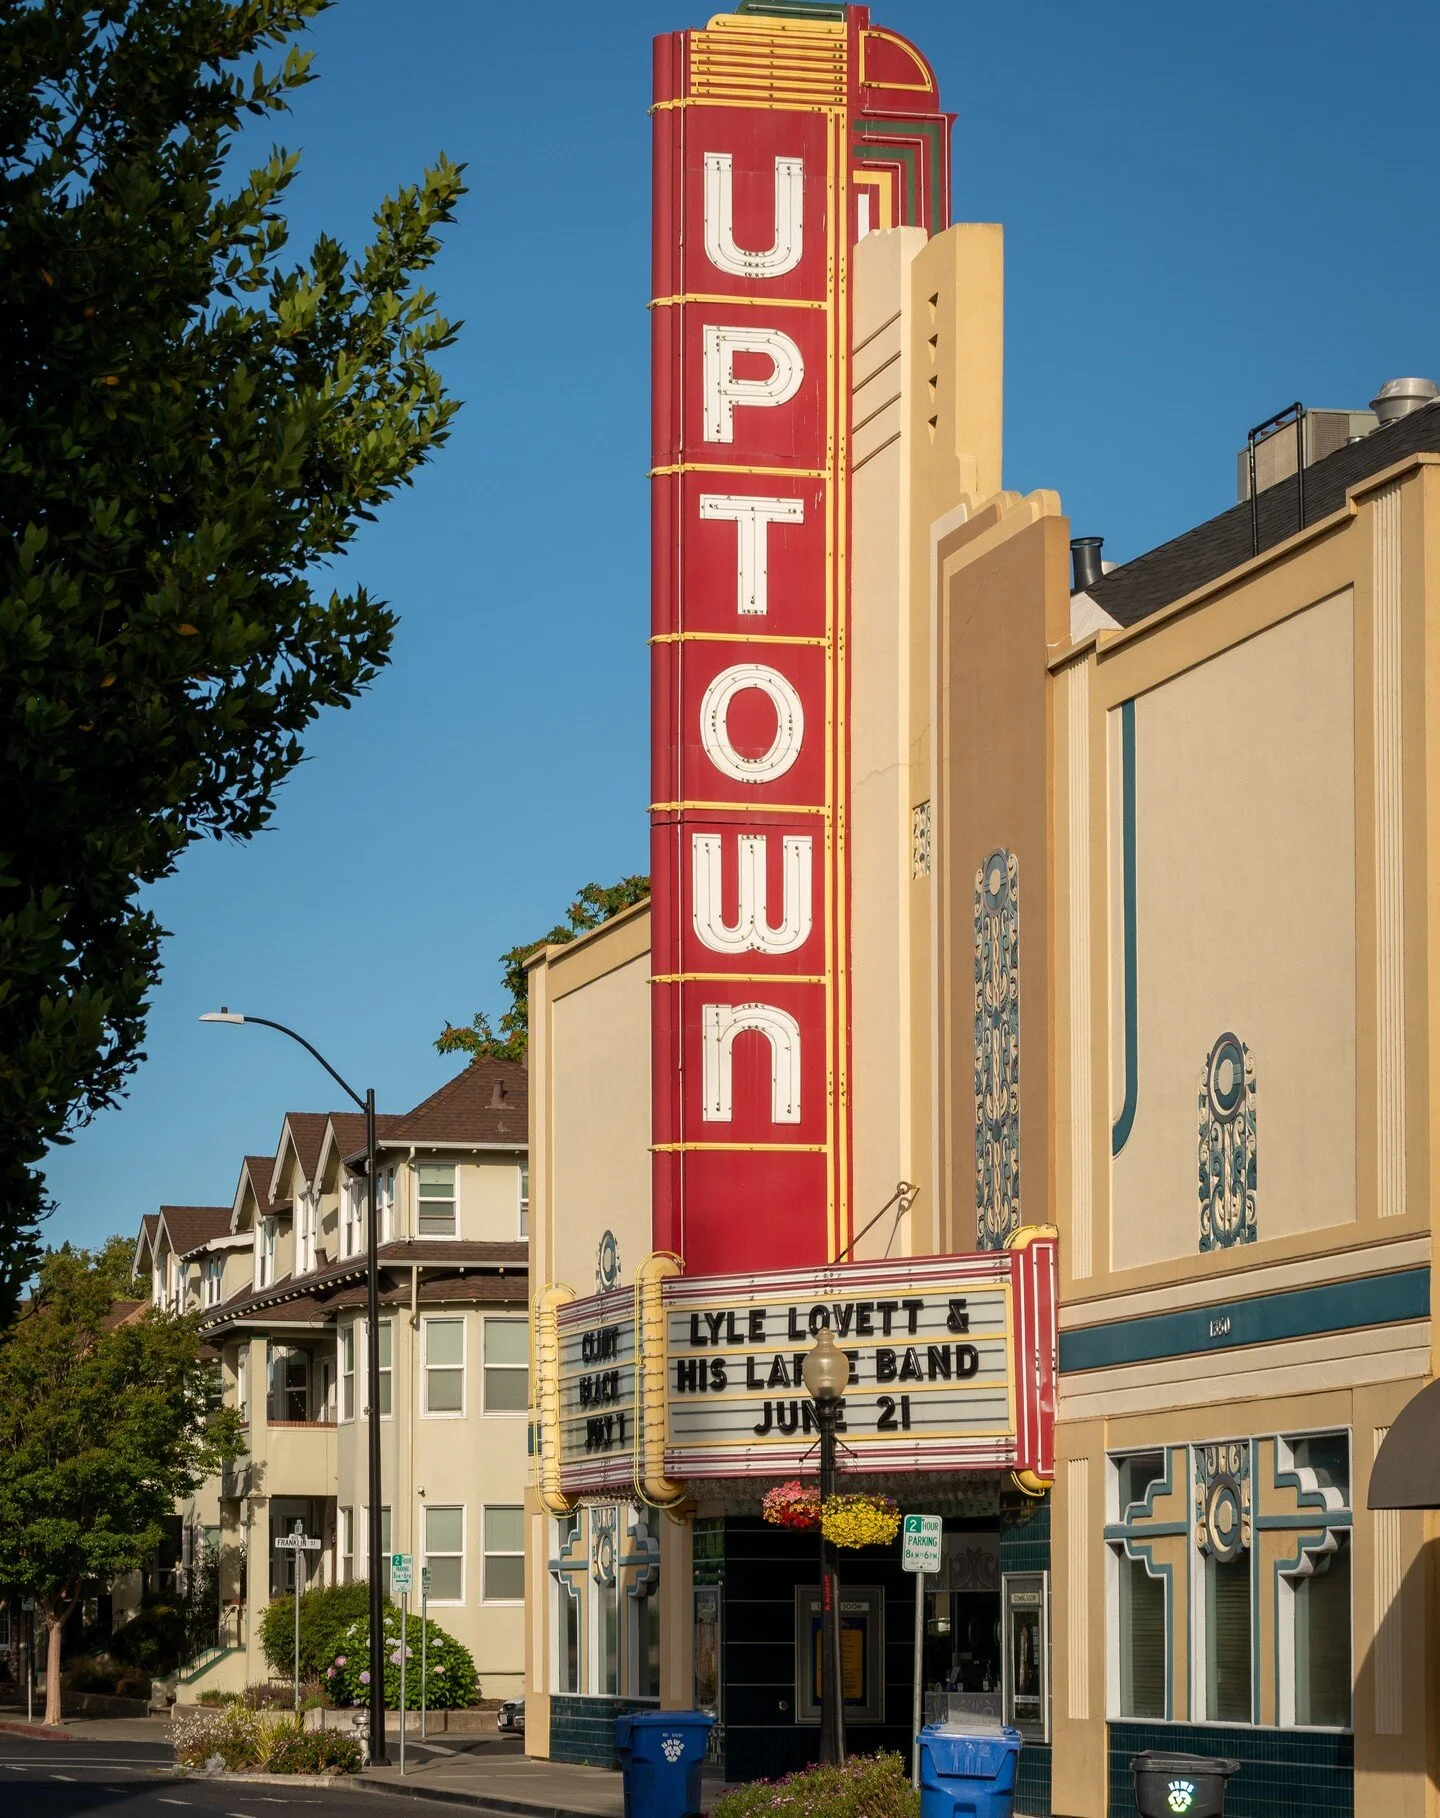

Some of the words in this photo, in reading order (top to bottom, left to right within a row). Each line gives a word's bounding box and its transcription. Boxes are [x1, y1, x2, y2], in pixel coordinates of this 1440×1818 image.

[692, 152, 814, 1124] UPTOWN
[690, 1309, 766, 1345] LYLE
[788, 1299, 924, 1341] LOVETT
[947, 1298, 970, 1334] &
[677, 1358, 728, 1392] HIS
[876, 1344, 979, 1384] BAND
[877, 1395, 911, 1432] 21
[277, 1538, 307, 1548] FRANKLIN
[908, 1536, 938, 1547] PARKING
[910, 1519, 917, 1532] 2
[922, 1521, 939, 1531] HOUR
